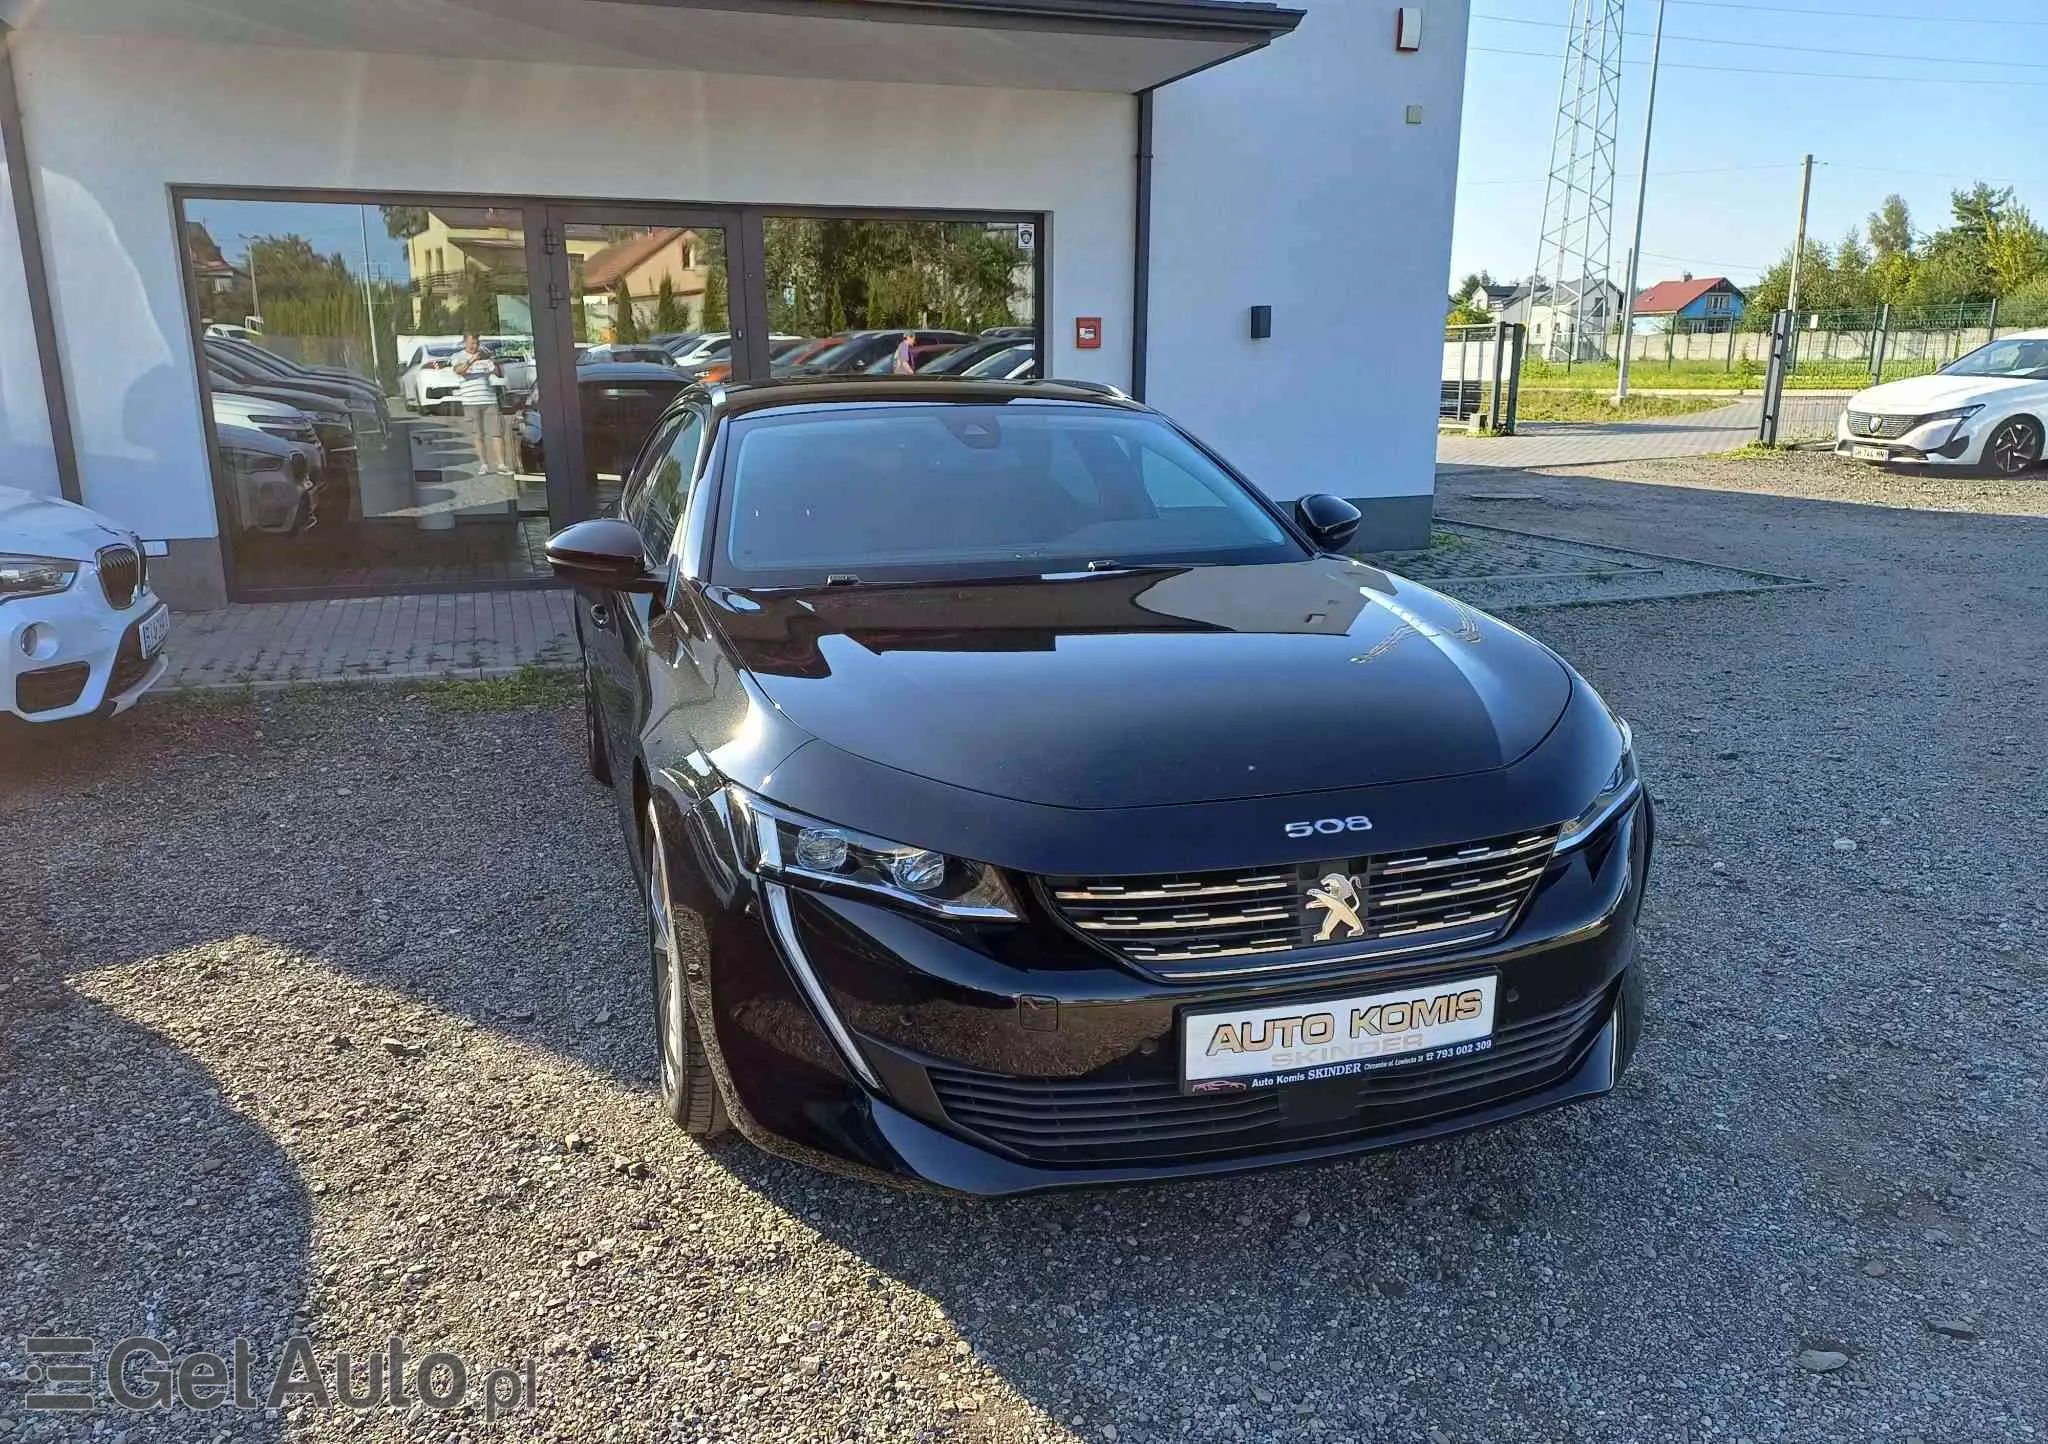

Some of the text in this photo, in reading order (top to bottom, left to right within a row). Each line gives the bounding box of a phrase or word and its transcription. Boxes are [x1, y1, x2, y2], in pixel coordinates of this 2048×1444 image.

[1285, 815, 1373, 838] 508
[1205, 988, 1483, 1057] AUTO KOMIS
[1271, 1033, 1424, 1068] SKINDER
[1251, 1077, 1274, 1088] Auto
[1276, 1072, 1306, 1085] Komis
[1307, 1062, 1361, 1080] SKINDER
